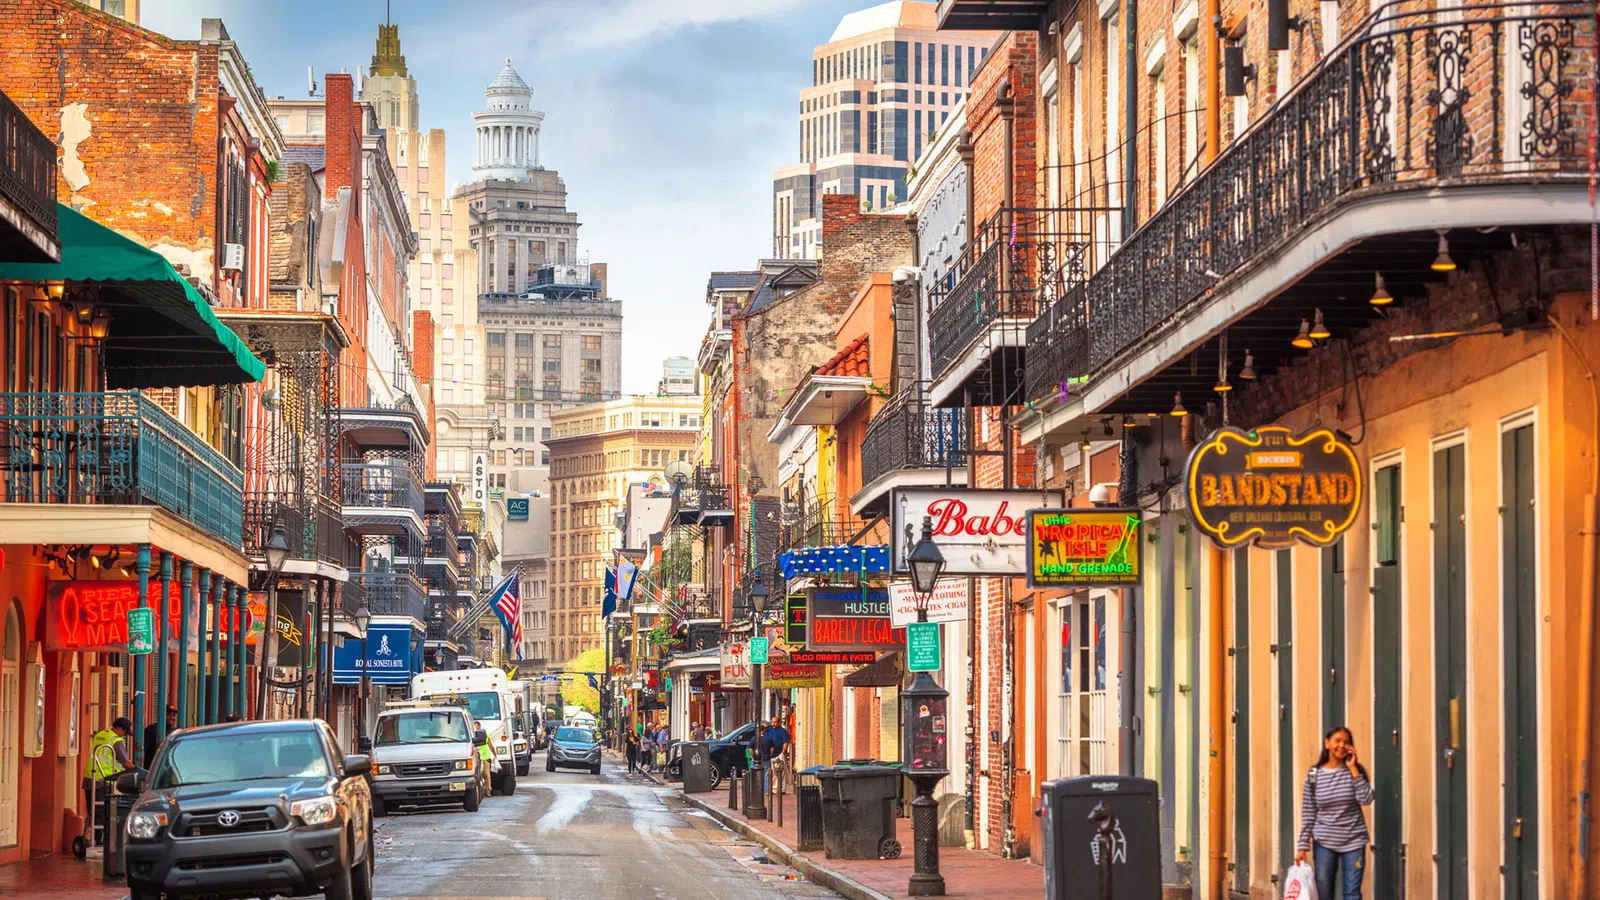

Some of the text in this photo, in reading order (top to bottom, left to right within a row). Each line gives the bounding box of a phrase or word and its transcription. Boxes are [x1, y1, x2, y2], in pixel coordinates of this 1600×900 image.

[1201, 472, 1354, 507] BANDSTAND
[510, 501, 526, 510] AC
[927, 498, 1026, 537] Babe
[1036, 524, 1135, 540] TROPICAL
[1065, 541, 1107, 557] ISLE
[1041, 563, 1133, 574] HAND GRENADE
[82, 582, 181, 602] PIER 24
[931, 591, 966, 600] CLOTHING
[86, 596, 182, 624] SEAOD
[899, 604, 942, 614] CIGATES
[86, 618, 182, 646] MAT
[815, 619, 858, 645] BARELY
[861, 618, 896, 644] LEGAL
[355, 659, 373, 668] ROAL
[373, 659, 392, 667] SONESTA
[791, 653, 814, 662] TACO
[842, 653, 848, 661] &
[850, 653, 874, 662] PATIO
[724, 665, 745, 678] FU
